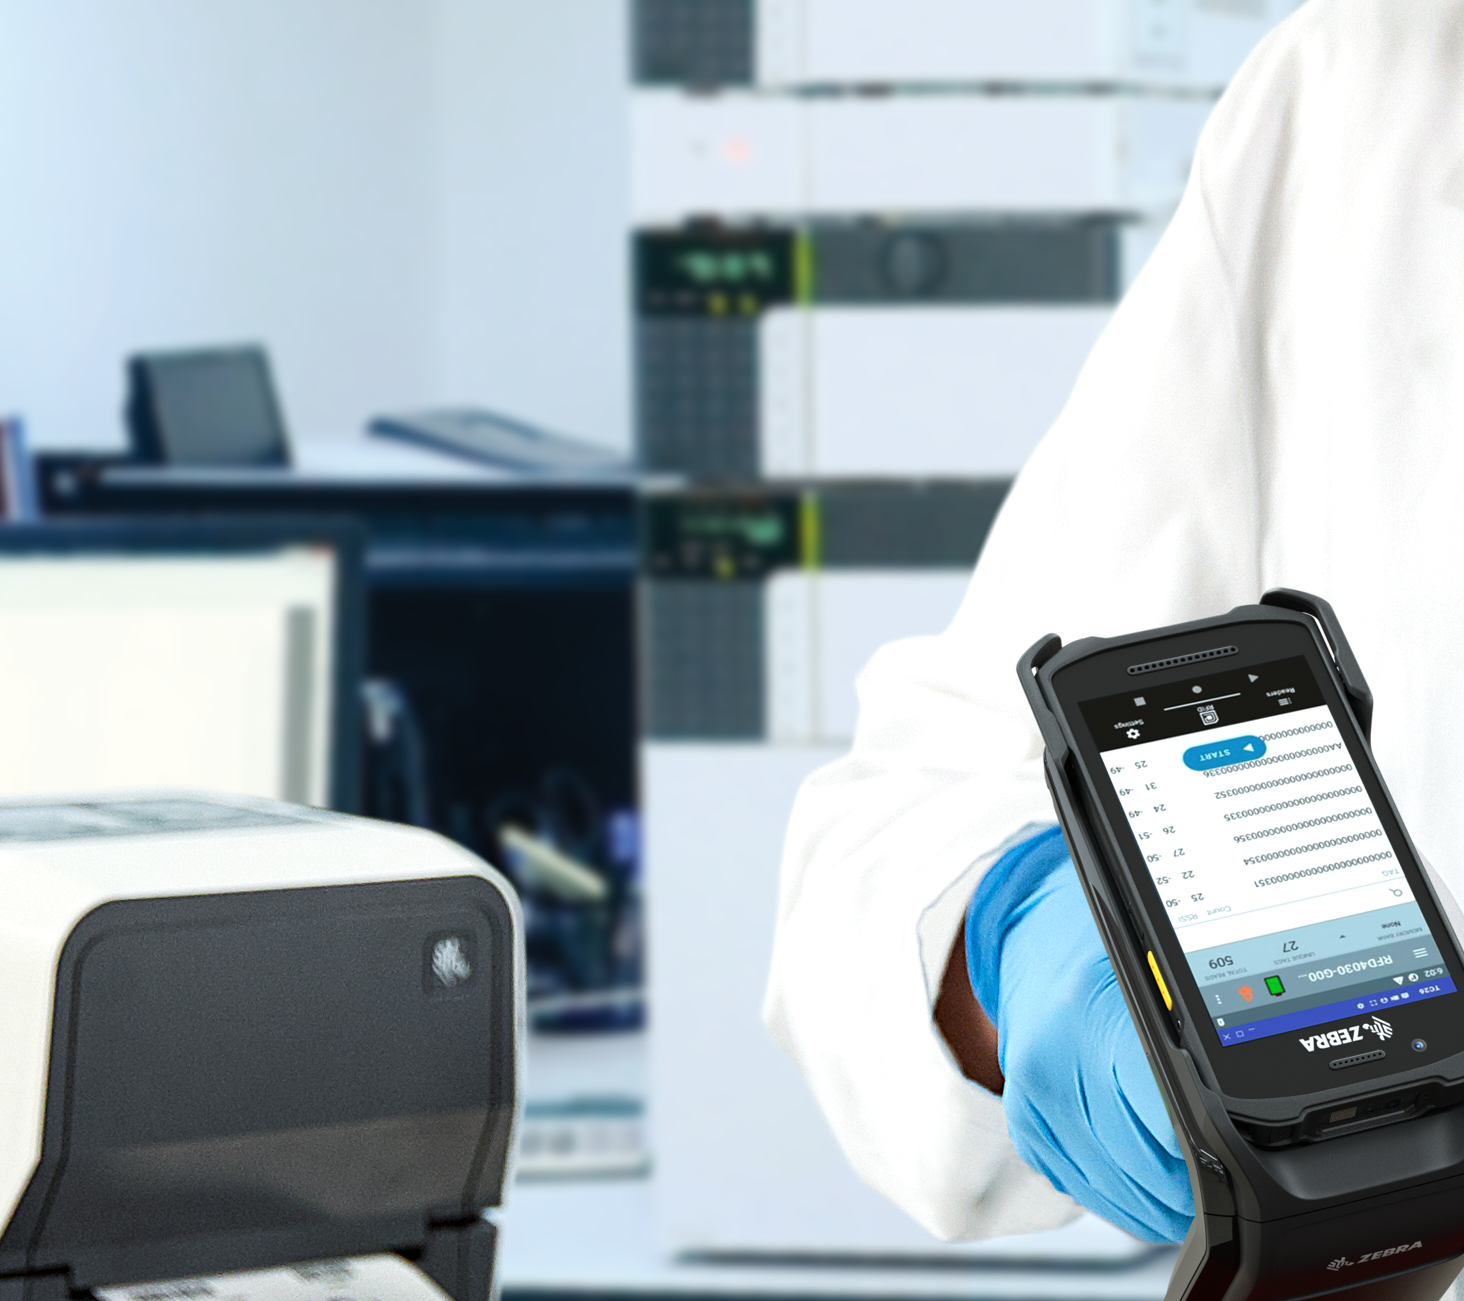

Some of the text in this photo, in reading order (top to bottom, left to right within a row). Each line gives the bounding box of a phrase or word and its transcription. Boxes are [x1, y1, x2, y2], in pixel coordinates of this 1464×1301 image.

[1265, 687, 1295, 697] Readers
[1196, 704, 1214, 712] RFID
[1113, 718, 1144, 729] Settings
[1199, 748, 1230, 761] START
[1134, 760, 1147, 769] 25
[1109, 766, 1124, 774] -49
[1144, 781, 1157, 790] 31
[1118, 788, 1133, 796] -49
[1153, 803, 1166, 812] 24
[1128, 810, 1142, 818] -49
[1162, 825, 1175, 834] 26
[1138, 831, 1152, 840] -51
[1173, 847, 1185, 857] 27
[1146, 853, 1161, 862] -50
[1181, 870, 1194, 879] 22
[1156, 876, 1171, 885] -52
[1177, 868, 1399, 922] TAG Count RSSI
[1190, 892, 1204, 902] 25
[1165, 898, 1180, 907] -50
[1381, 920, 1401, 928] None
[1376, 926, 1423, 941] MEMORY BANK
[1282, 940, 1298, 953] 27
[1208, 955, 1233, 969] 509
[1272, 951, 1315, 965] UNIQUE TAGS
[1204, 967, 1247, 981] TOTAL READS
[1423, 967, 1443, 977] 6:02
[1418, 984, 1440, 994] TC26
[1299, 1025, 1363, 1052] ZEBRA
[1357, 1241, 1423, 1264] ZEBRA
